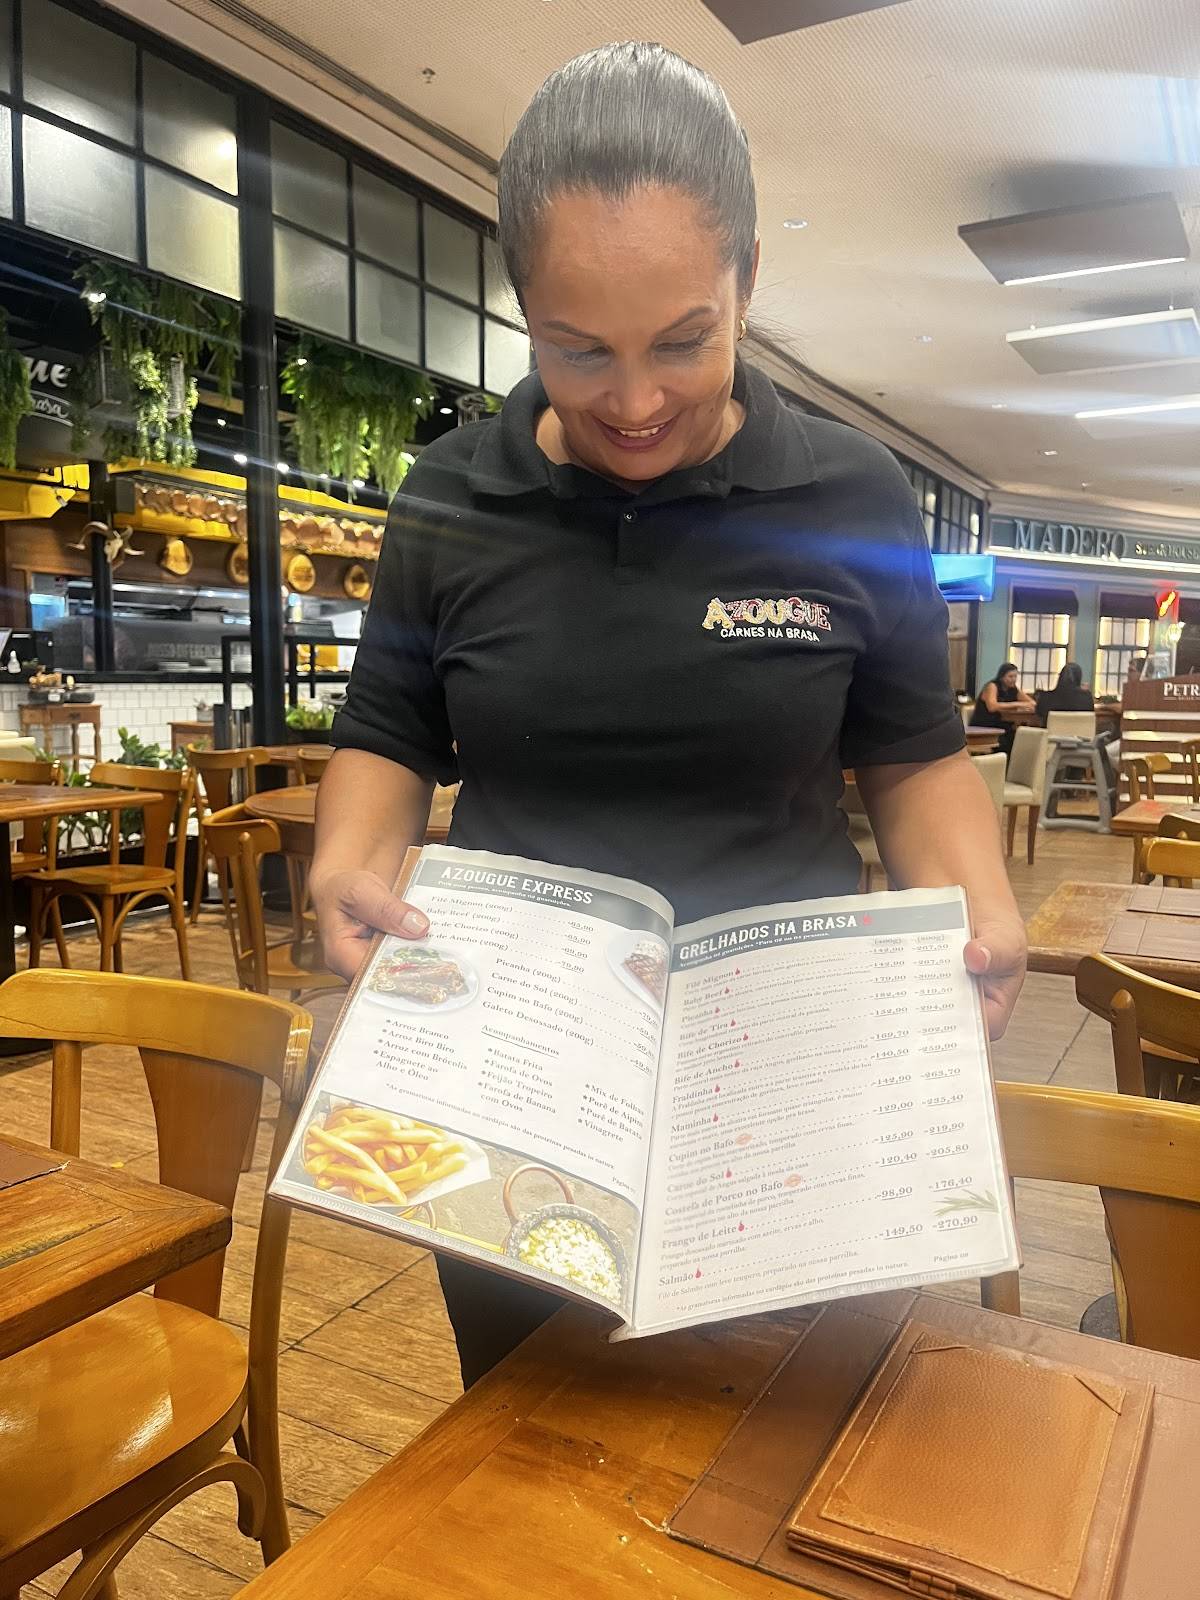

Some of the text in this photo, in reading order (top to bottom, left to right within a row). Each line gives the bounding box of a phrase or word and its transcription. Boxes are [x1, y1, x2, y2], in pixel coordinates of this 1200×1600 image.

[1014, 519, 1128, 559] MADERO
[702, 597, 832, 631] AZOUGUE
[720, 627, 820, 642] CARNES NA BRASA
[440, 866, 519, 889] AZOUGUE
[522, 878, 594, 905] EXPRESS
[427, 907, 449, 915] Baby
[450, 909, 469, 917] Beef
[450, 896, 483, 907] Mignon
[449, 935, 478, 943] Ancho
[455, 922, 489, 932] Chorizo
[679, 925, 769, 960] GRELHADOS
[774, 921, 796, 936] NA
[802, 915, 858, 932] BRASA
[496, 958, 561, 984] Picanha (200g)
[702, 969, 733, 986] Mignon
[491, 971, 578, 1006] Carne do Sol (200g)
[704, 989, 723, 1000] Beef
[487, 986, 584, 1025] Cupim no Bafo (200g)
[681, 1008, 713, 1023] Picanha
[391, 1019, 449, 1040] Arroz Branco
[482, 1000, 594, 1047] Galeto Desossado (200g)
[698, 1027, 708, 1035] de
[711, 1021, 728, 1031] Tira
[388, 1029, 456, 1054] Arroz Biro Biro
[481, 1024, 560, 1056] Acompanhamentos
[678, 1049, 693, 1059] Bife
[696, 1046, 706, 1054] de
[708, 1036, 742, 1051] Chorizo
[379, 1050, 439, 1073] Espaguete ao
[383, 1039, 468, 1071] Arroz com Brócolis
[493, 1048, 544, 1072] Batata Frita
[375, 1060, 398, 1072] Alho
[407, 1067, 429, 1081] Óleo
[490, 1059, 553, 1088] Farofa de Ovos
[674, 1073, 691, 1085] Bife
[693, 1070, 703, 1079] de
[705, 1062, 733, 1076] Ancho
[487, 1070, 553, 1100] Feijão Tropeiro
[672, 1086, 713, 1104] Fraldinha
[481, 1094, 523, 1113] com Ovos
[483, 1081, 557, 1115] Farofa de Banana
[590, 1083, 644, 1116] Mix de Folhas
[586, 1106, 643, 1141] Purê de Batata
[588, 1095, 643, 1129] Purê de Aipim
[671, 1115, 711, 1133] Maminha
[584, 1119, 624, 1143] Vinagrete
[668, 1147, 698, 1164] Cupim
[700, 1146, 711, 1154] no
[713, 1137, 734, 1151] Bafo
[696, 1175, 708, 1186] do
[710, 1170, 724, 1182] Sol
[664, 1200, 700, 1216] Costela
[702, 1196, 714, 1208] de
[715, 1189, 743, 1205] Porco
[746, 1188, 758, 1197] no
[760, 1178, 783, 1193] Bafo
[662, 1233, 696, 1251] Frango
[698, 1230, 709, 1242] de
[712, 1223, 737, 1238] Leite
[876, 1186, 913, 1198] -98,90
[658, 1215, 978, 1287] Salmão -149,50 -270,90
[817, 1272, 848, 1284] proteínas
[849, 1266, 874, 1278] pesadas
